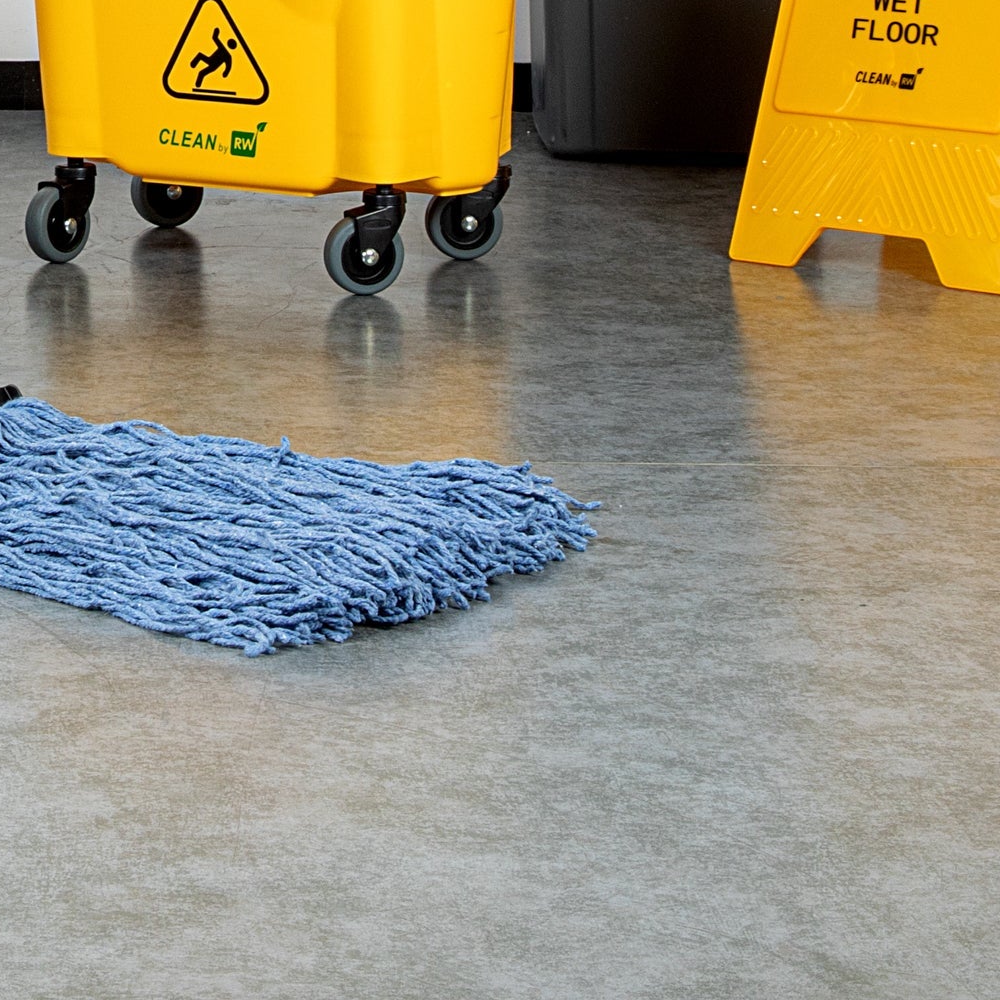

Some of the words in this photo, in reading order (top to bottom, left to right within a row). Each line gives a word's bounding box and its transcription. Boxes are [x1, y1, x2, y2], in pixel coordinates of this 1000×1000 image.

[851, 18, 939, 46] FLOOR
[855, 70, 892, 85] CLEAN
[159, 128, 217, 151] CLEAN
[218, 144, 229, 154] by
[233, 135, 256, 152] RW
